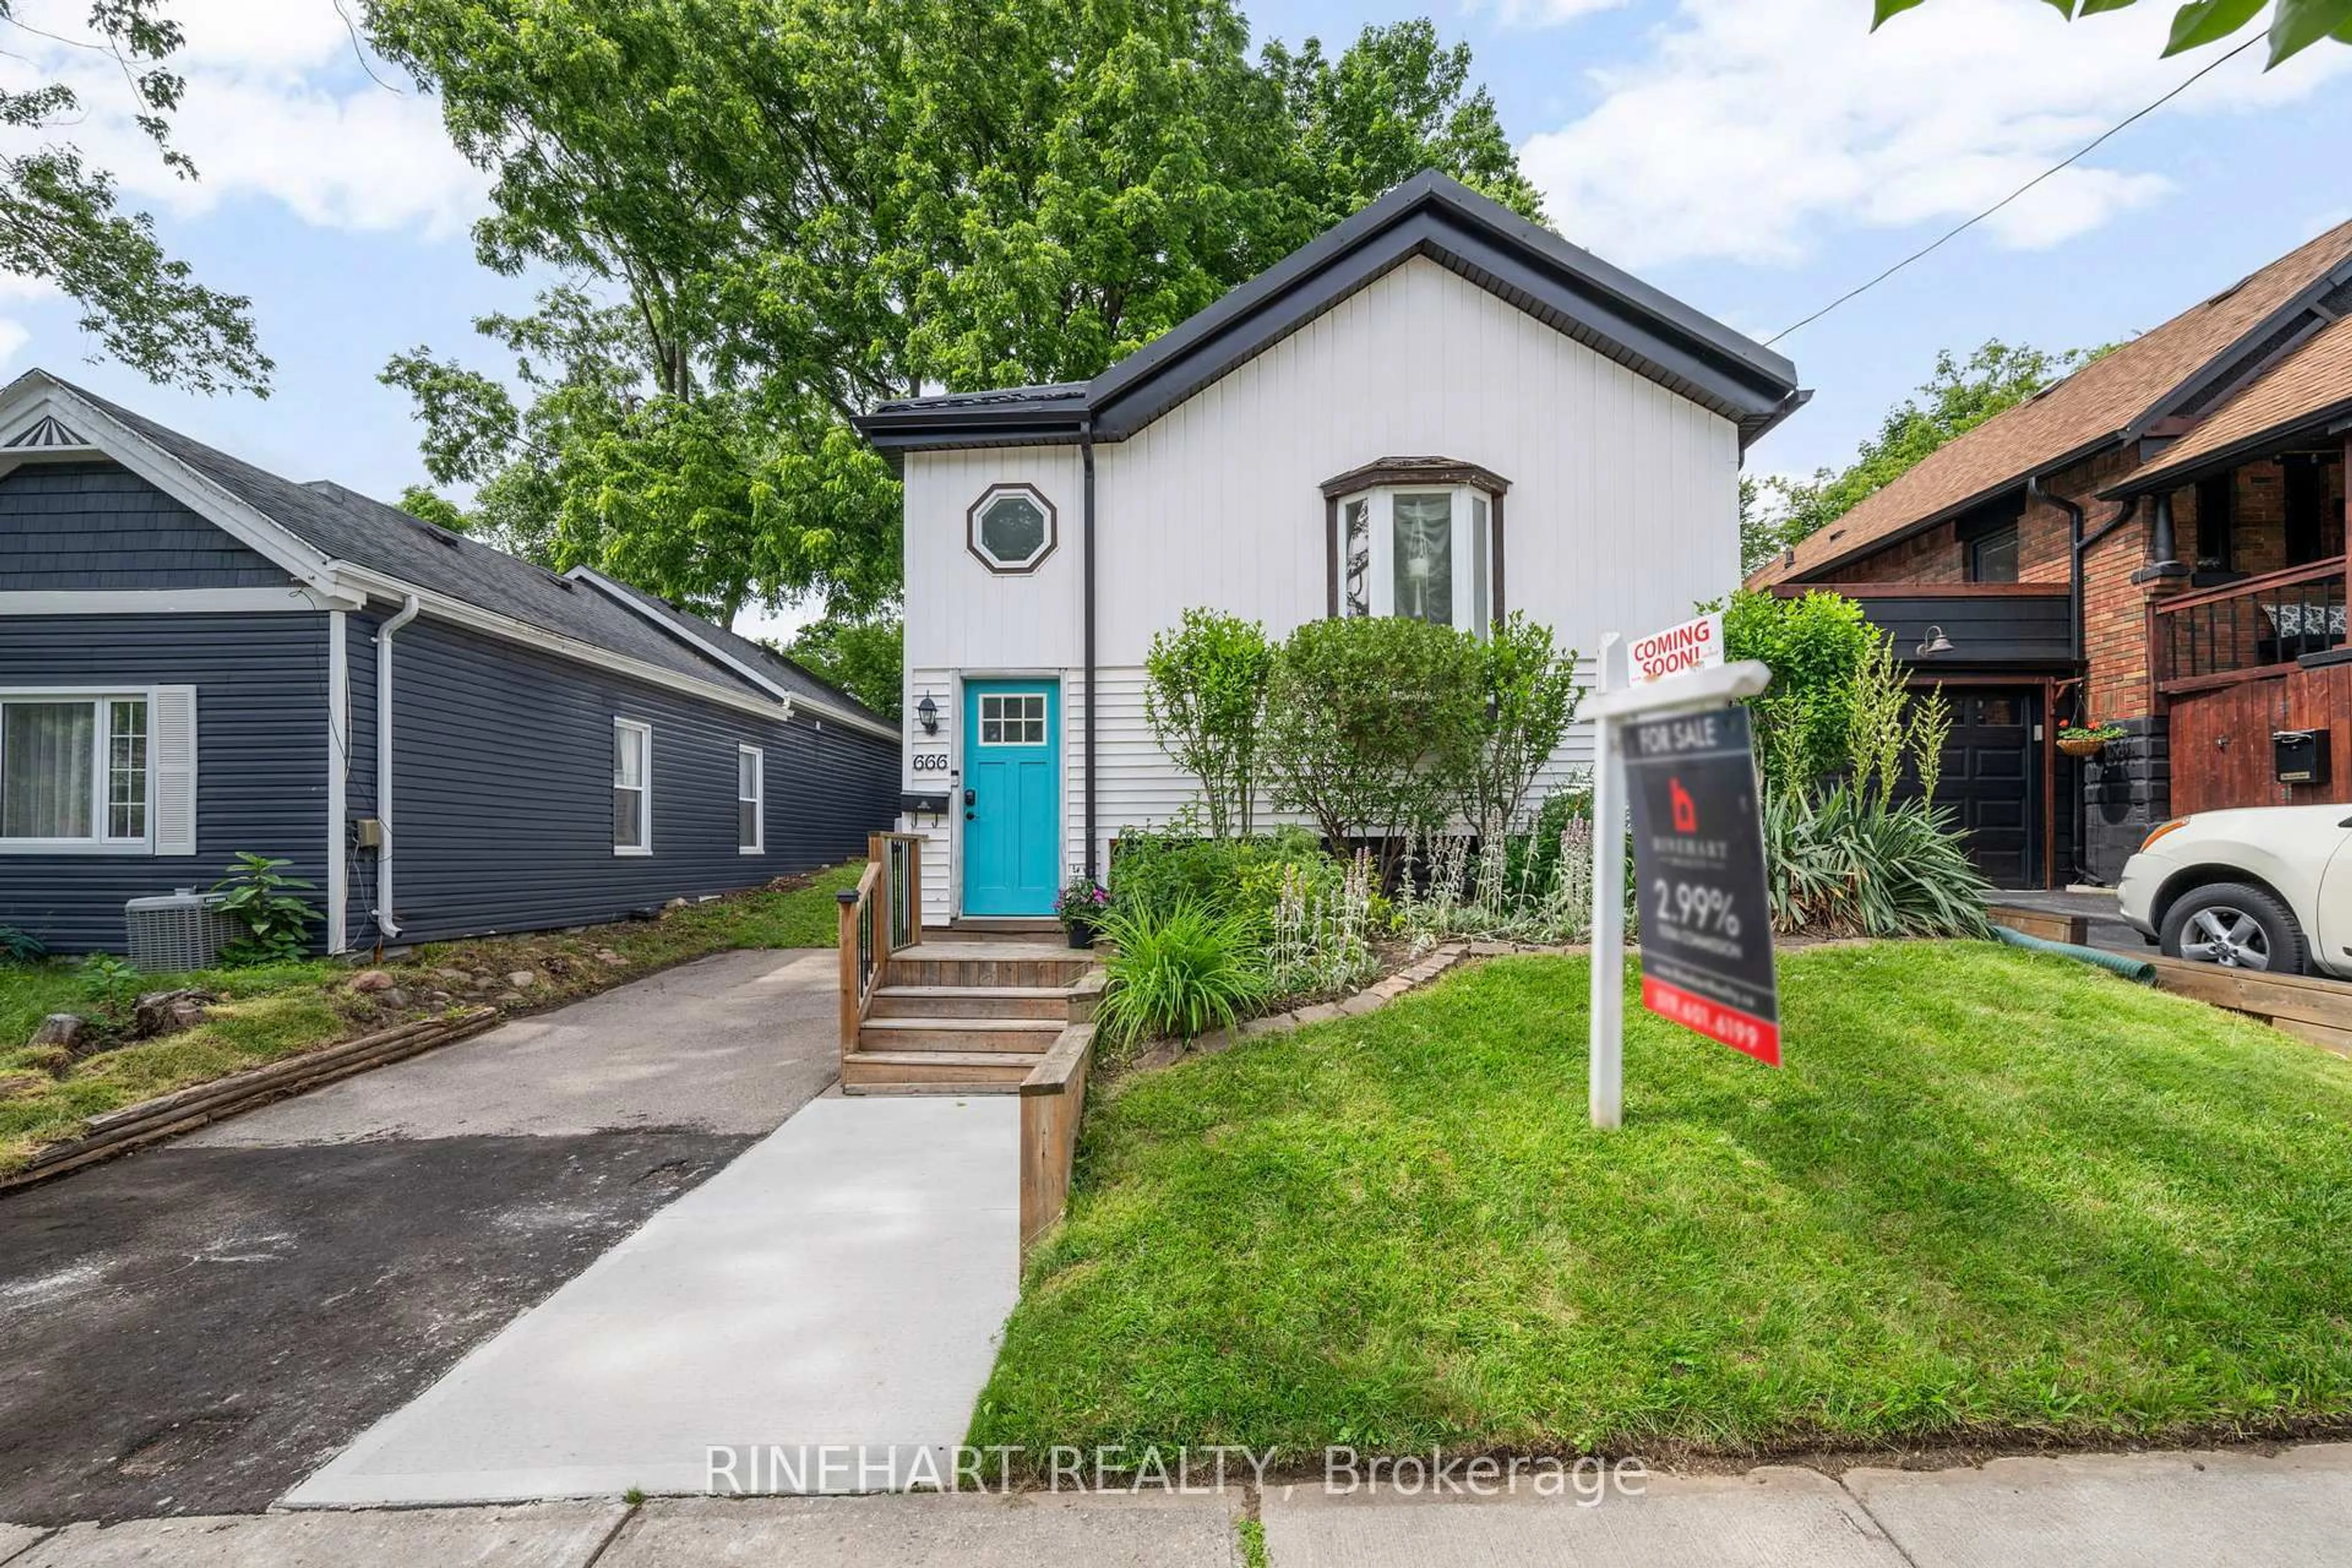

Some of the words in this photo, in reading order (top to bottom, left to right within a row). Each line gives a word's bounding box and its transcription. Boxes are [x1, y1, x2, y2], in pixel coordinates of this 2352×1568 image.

[1635, 620, 1709, 661] COMING
[1643, 646, 1700, 676] SOON!
[1638, 723, 1670, 753] FOR
[1673, 718, 1717, 750] SALE
[913, 754, 948, 771] 666
[1654, 880, 1740, 937] 2.99%
